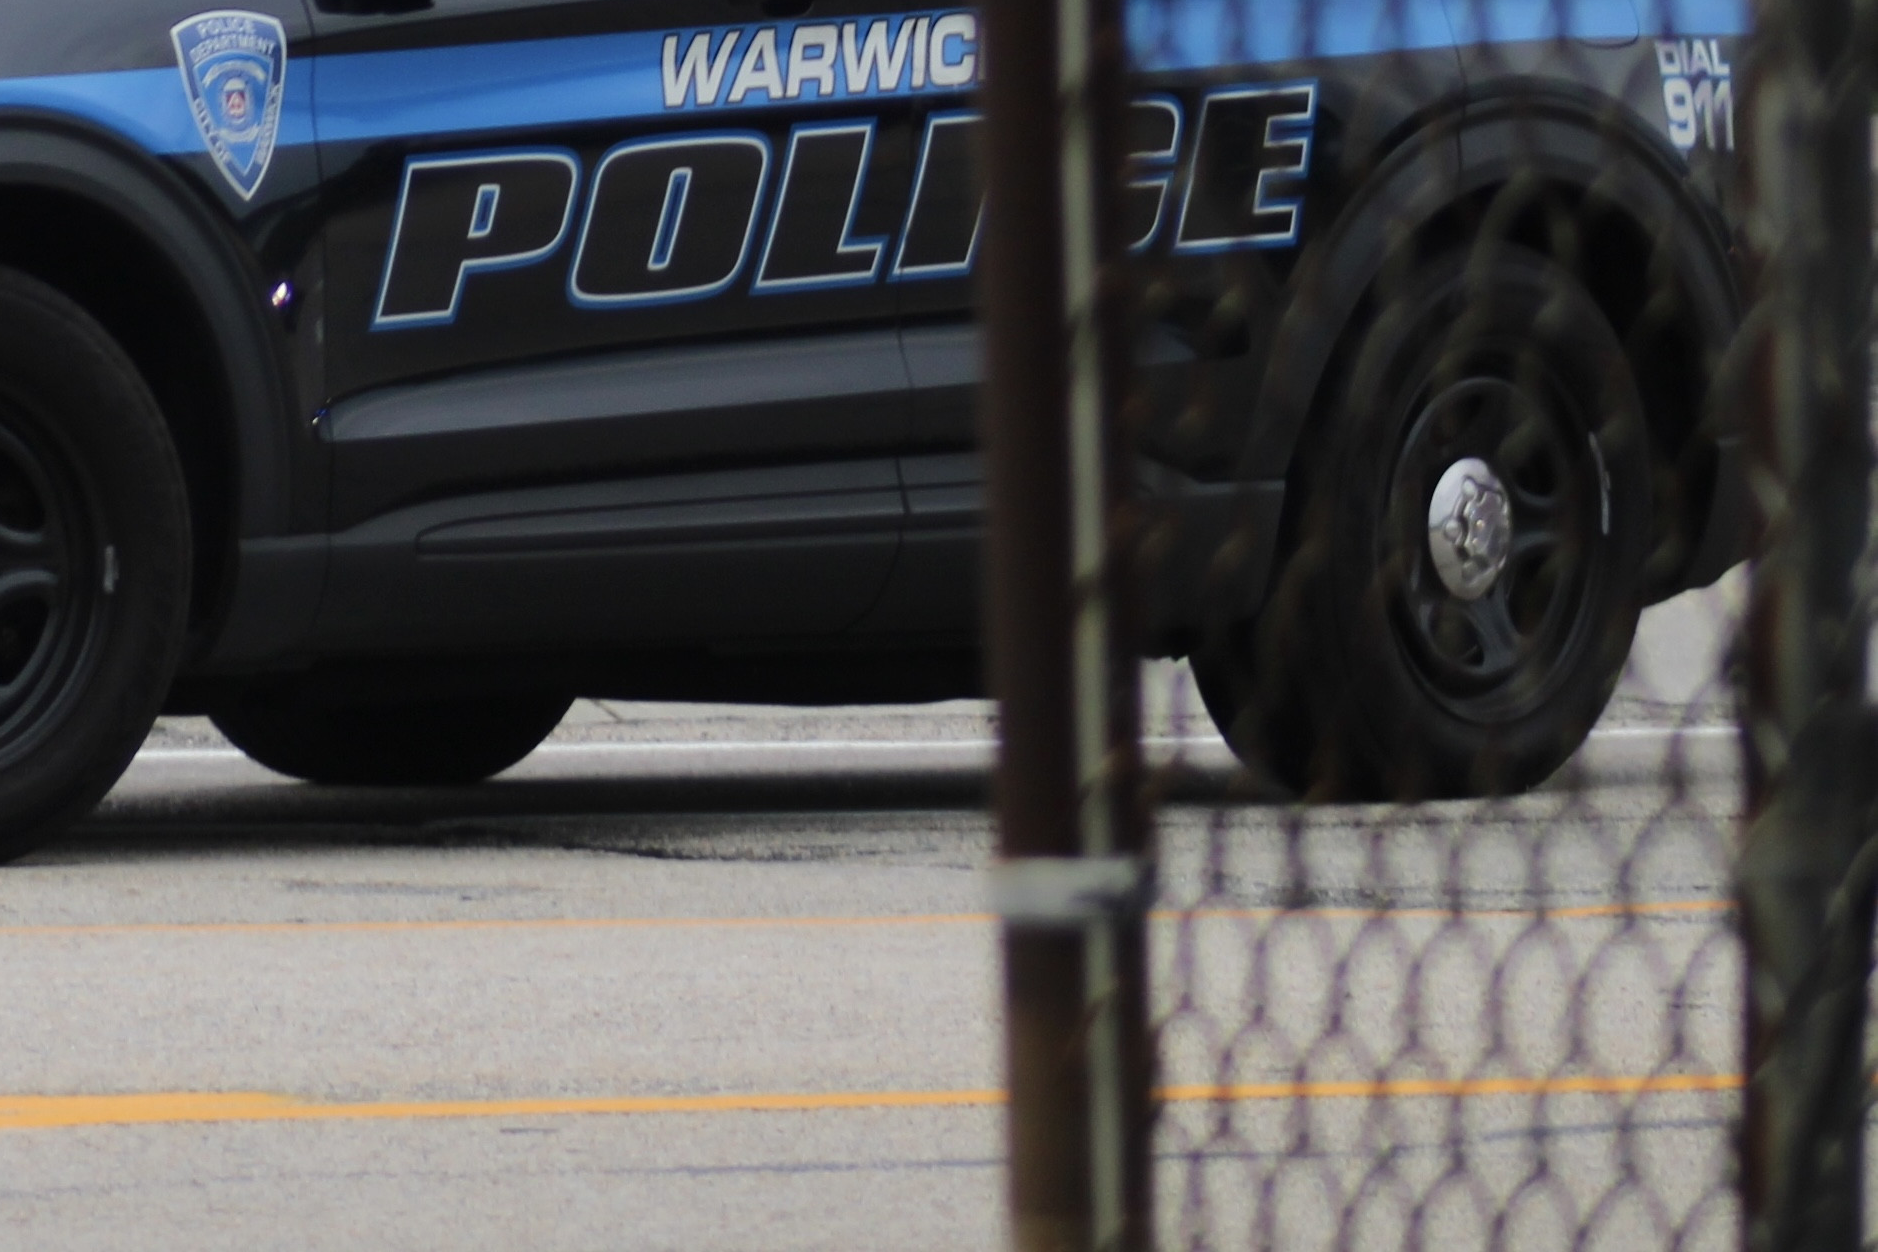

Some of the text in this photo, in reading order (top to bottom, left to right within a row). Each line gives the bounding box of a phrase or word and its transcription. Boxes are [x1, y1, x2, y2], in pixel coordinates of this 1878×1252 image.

[662, 12, 985, 108] WARWIC
[1654, 38, 1731, 77] DIAL
[1663, 77, 1735, 152] 911
